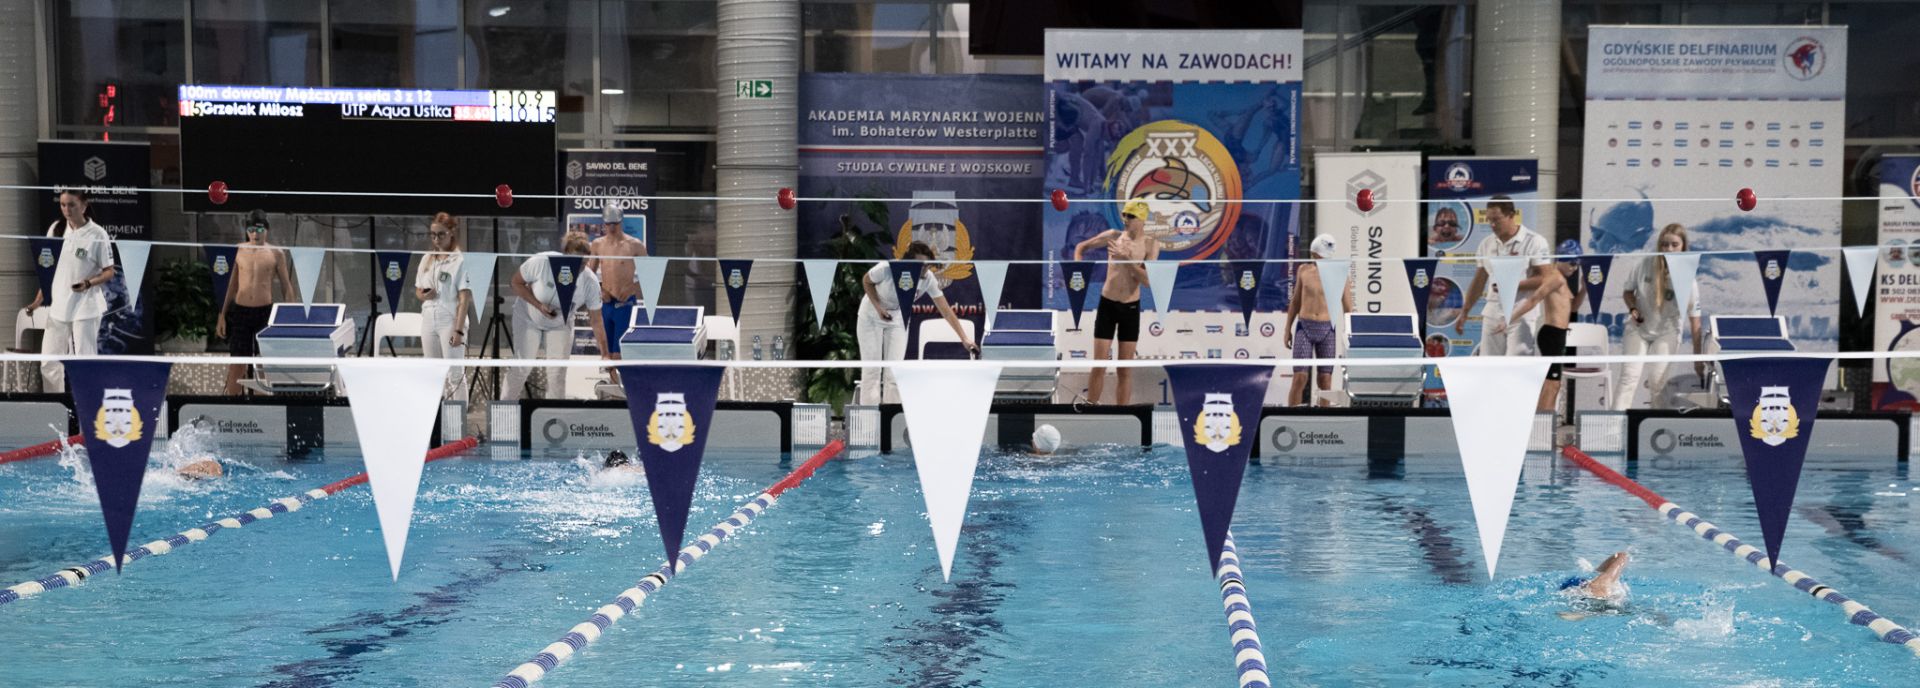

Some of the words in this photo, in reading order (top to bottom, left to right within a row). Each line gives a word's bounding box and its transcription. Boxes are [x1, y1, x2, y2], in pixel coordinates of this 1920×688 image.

[1603, 41, 1675, 56] GDYŃSKIE
[1679, 43, 1777, 56] DELFINARIUM
[1056, 53, 1131, 69] WITAMY
[1142, 53, 1168, 69] NA
[1178, 53, 1293, 70] ZAWODACH!
[1682, 58, 1722, 66] ZAWODY
[180, 85, 217, 99] 100m
[221, 86, 282, 102] dowolny
[358, 89, 391, 102] seria
[394, 90, 402, 102] 3
[418, 90, 432, 102] 12
[202, 102, 256, 116] Grzelak
[342, 105, 367, 117] UTP
[371, 105, 410, 120] Aqua
[414, 106, 451, 118] Ustka
[808, 110, 884, 122] AKADEMIA
[890, 110, 978, 122] MARYNARKI
[832, 125, 854, 137] im.
[860, 125, 937, 138] Bohaterów
[943, 126, 1037, 139] Westerplatte
[1146, 138, 1197, 157] XXX
[585, 162, 612, 171] SAVINO
[613, 162, 627, 171] DEL
[628, 162, 648, 171] BENE
[837, 162, 884, 173] STUDIA
[888, 163, 945, 174] CYWILNE
[950, 163, 955, 173] I
[960, 163, 1031, 174] WOJSKOWE
[565, 185, 593, 197] OUR
[1367, 225, 1383, 295] SAVINO
[1881, 274, 1895, 285] KS
